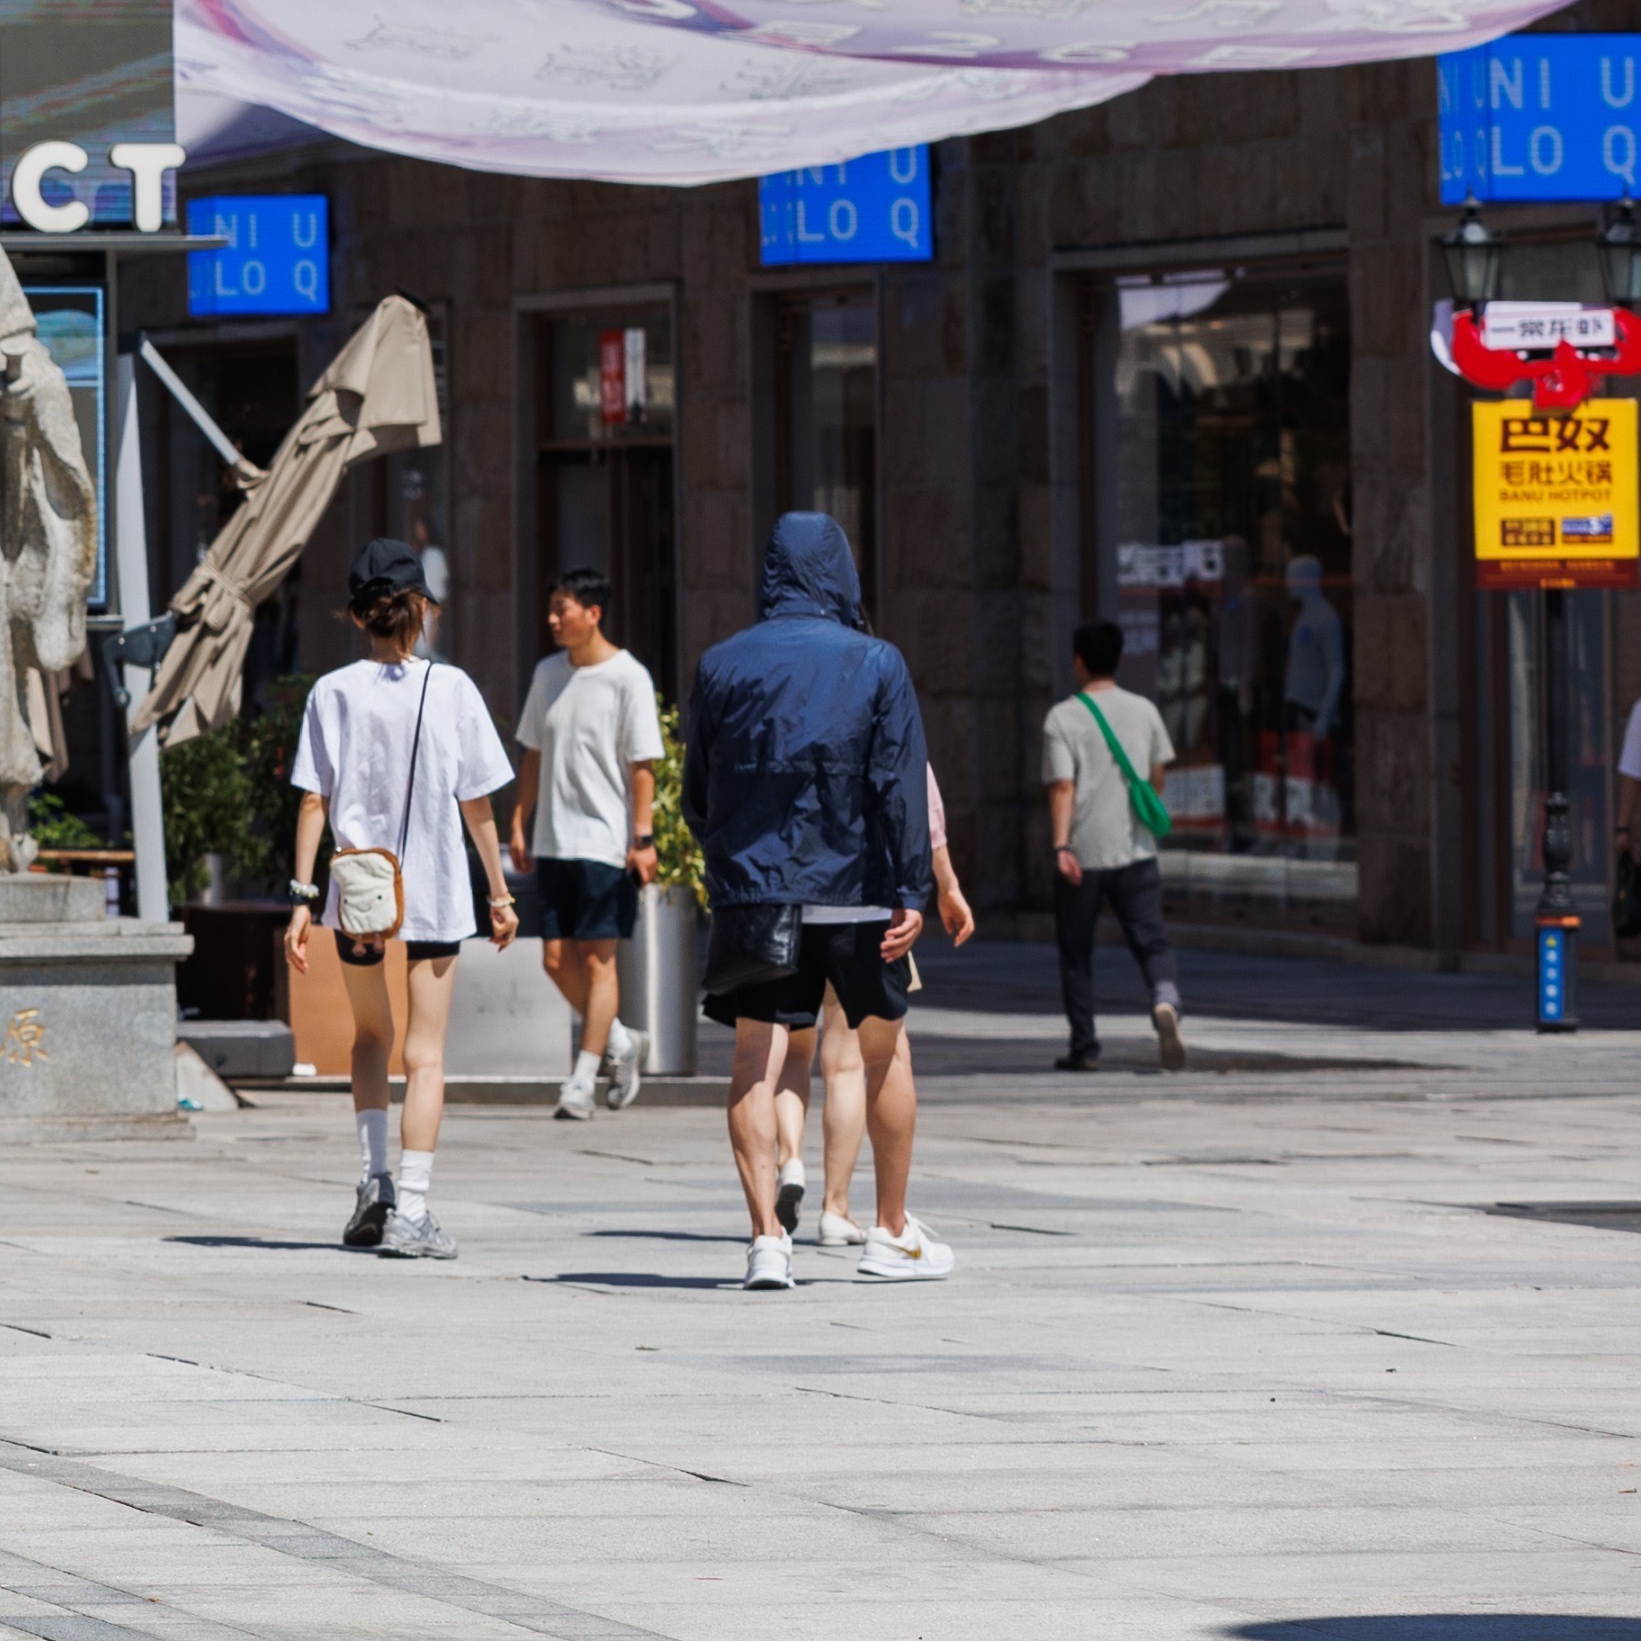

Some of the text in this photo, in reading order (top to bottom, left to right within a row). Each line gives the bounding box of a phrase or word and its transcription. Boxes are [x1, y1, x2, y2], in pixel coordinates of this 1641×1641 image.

[1500, 418, 1611, 453] 巴奴
[1501, 460, 1613, 486] 毛肚火锅
[1500, 489, 1612, 503] BANU HOTPOT
